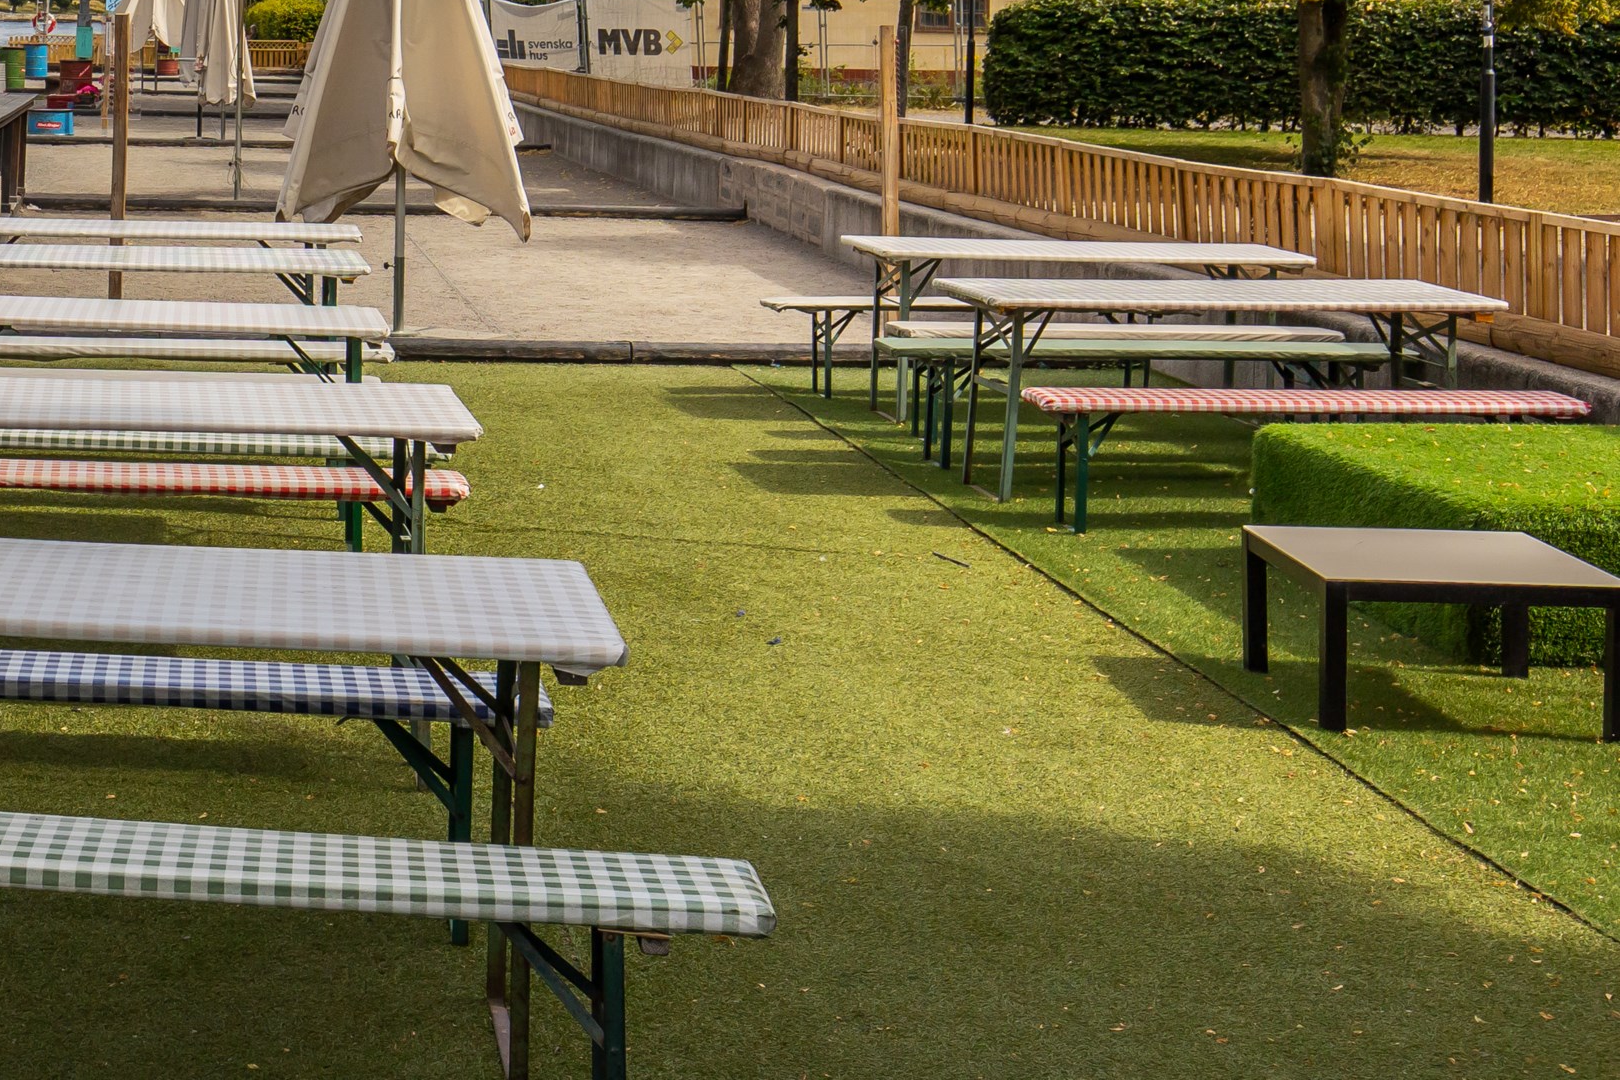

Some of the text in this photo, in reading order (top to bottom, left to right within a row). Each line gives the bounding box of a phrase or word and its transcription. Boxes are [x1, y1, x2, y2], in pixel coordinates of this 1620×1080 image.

[528, 39, 573, 50] svenska
[597, 28, 662, 56] MVB
[529, 50, 548, 61] hus
